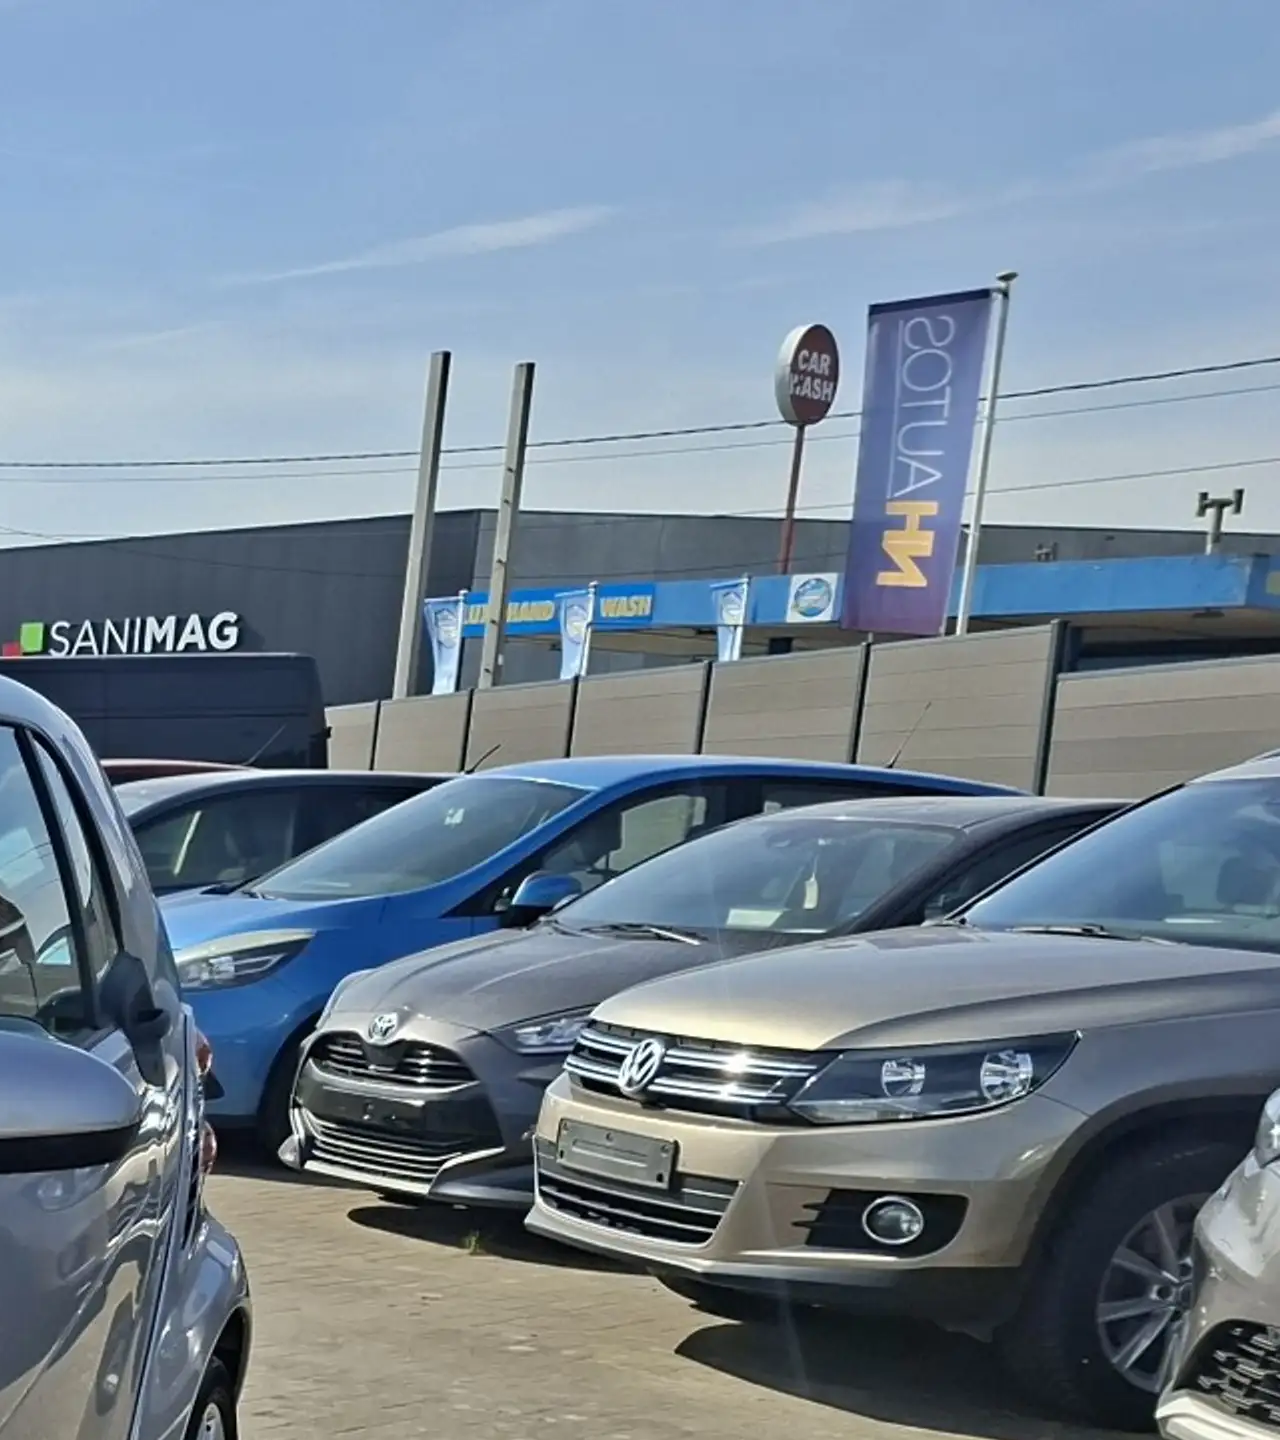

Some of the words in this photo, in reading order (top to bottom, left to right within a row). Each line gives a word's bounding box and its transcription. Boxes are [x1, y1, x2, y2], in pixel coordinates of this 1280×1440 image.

[797, 349, 831, 376] CAR
[789, 371, 834, 402] WASH
[599, 594, 653, 618] WASH
[48, 611, 239, 656] SANIMAG
